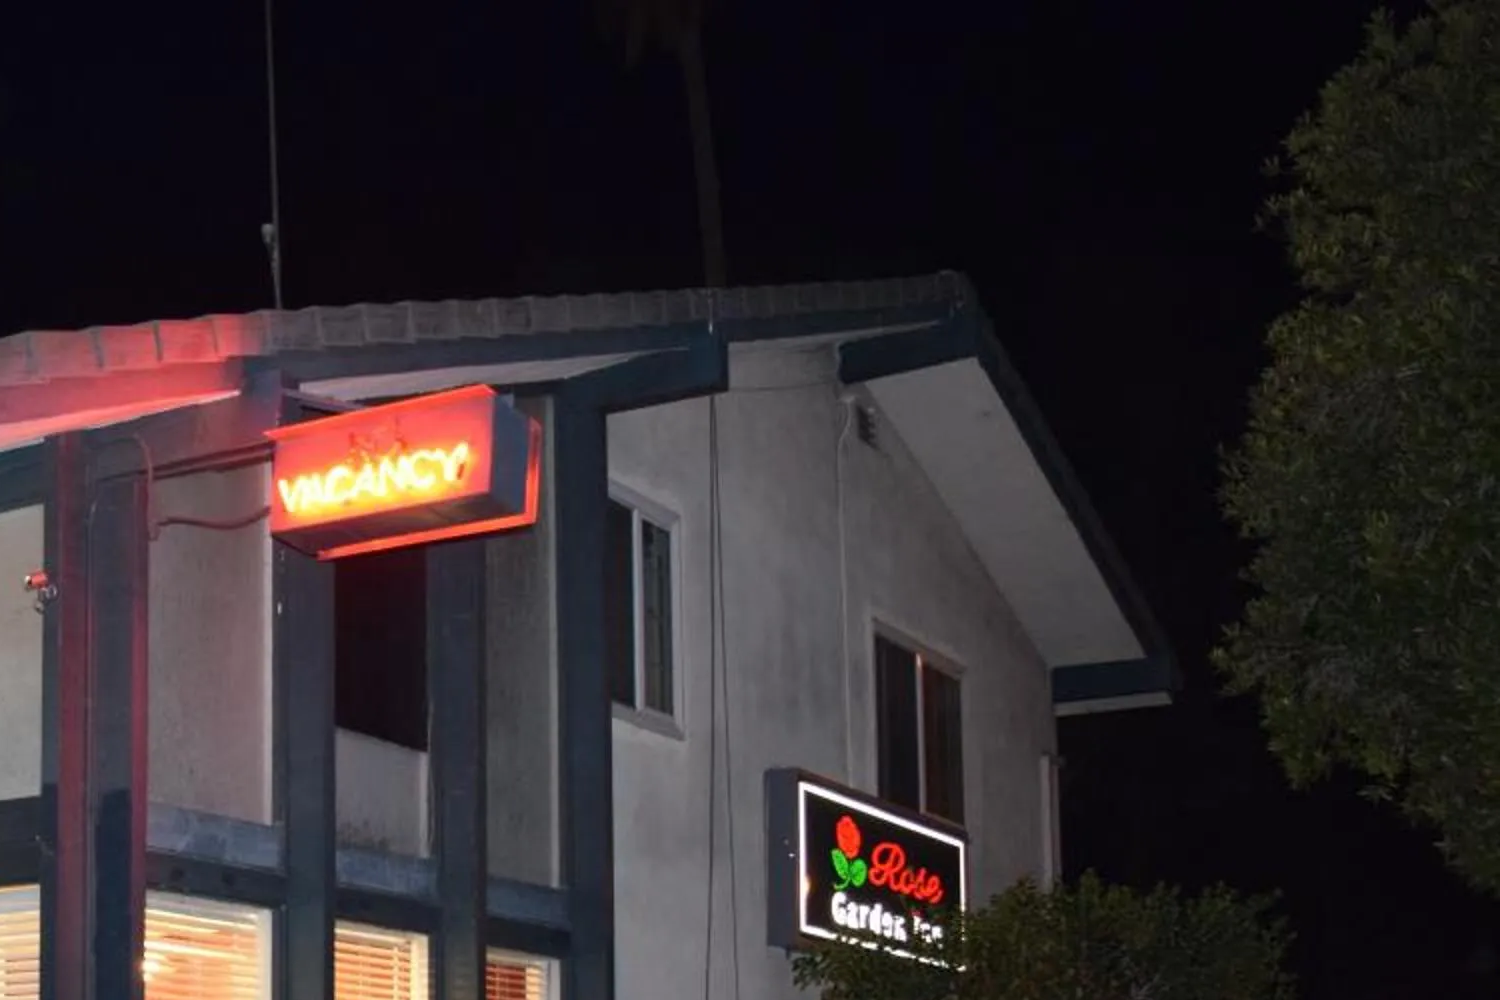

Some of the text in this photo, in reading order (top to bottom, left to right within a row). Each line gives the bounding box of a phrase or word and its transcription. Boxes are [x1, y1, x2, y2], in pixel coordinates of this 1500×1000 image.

[277, 440, 470, 514] VACANCY
[868, 841, 944, 904] Rose
[831, 891, 908, 942] Garden
